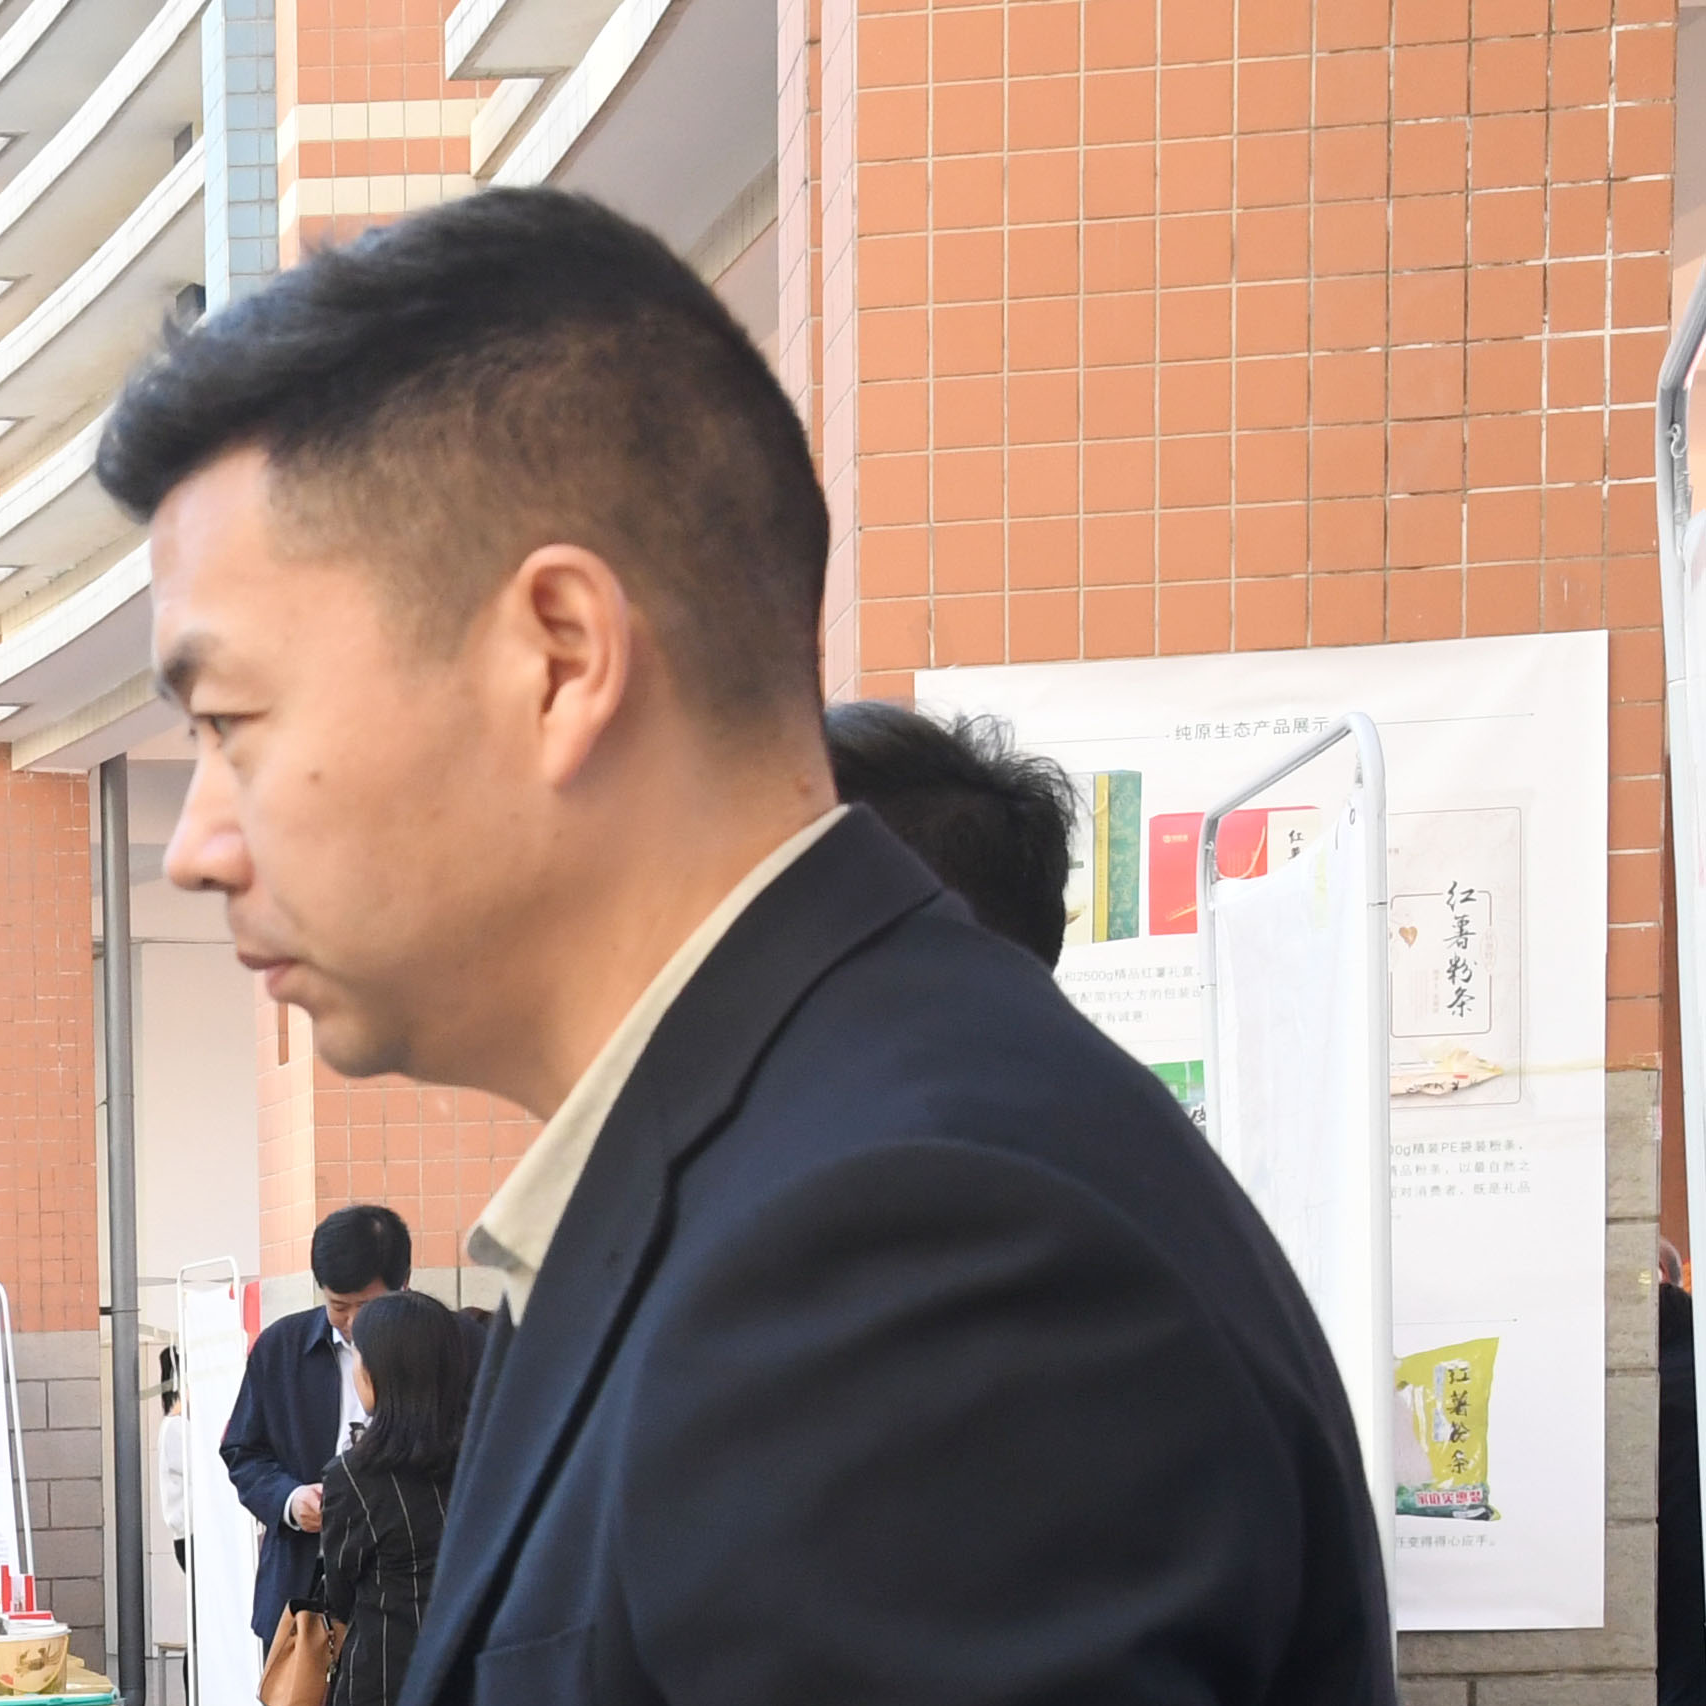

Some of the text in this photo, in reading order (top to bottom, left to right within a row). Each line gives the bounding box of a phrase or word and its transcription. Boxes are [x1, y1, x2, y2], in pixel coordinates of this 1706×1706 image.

[1175, 716, 1330, 740] 纯原生态产品展示
[1444, 881, 1477, 1018] 红薯粉条
